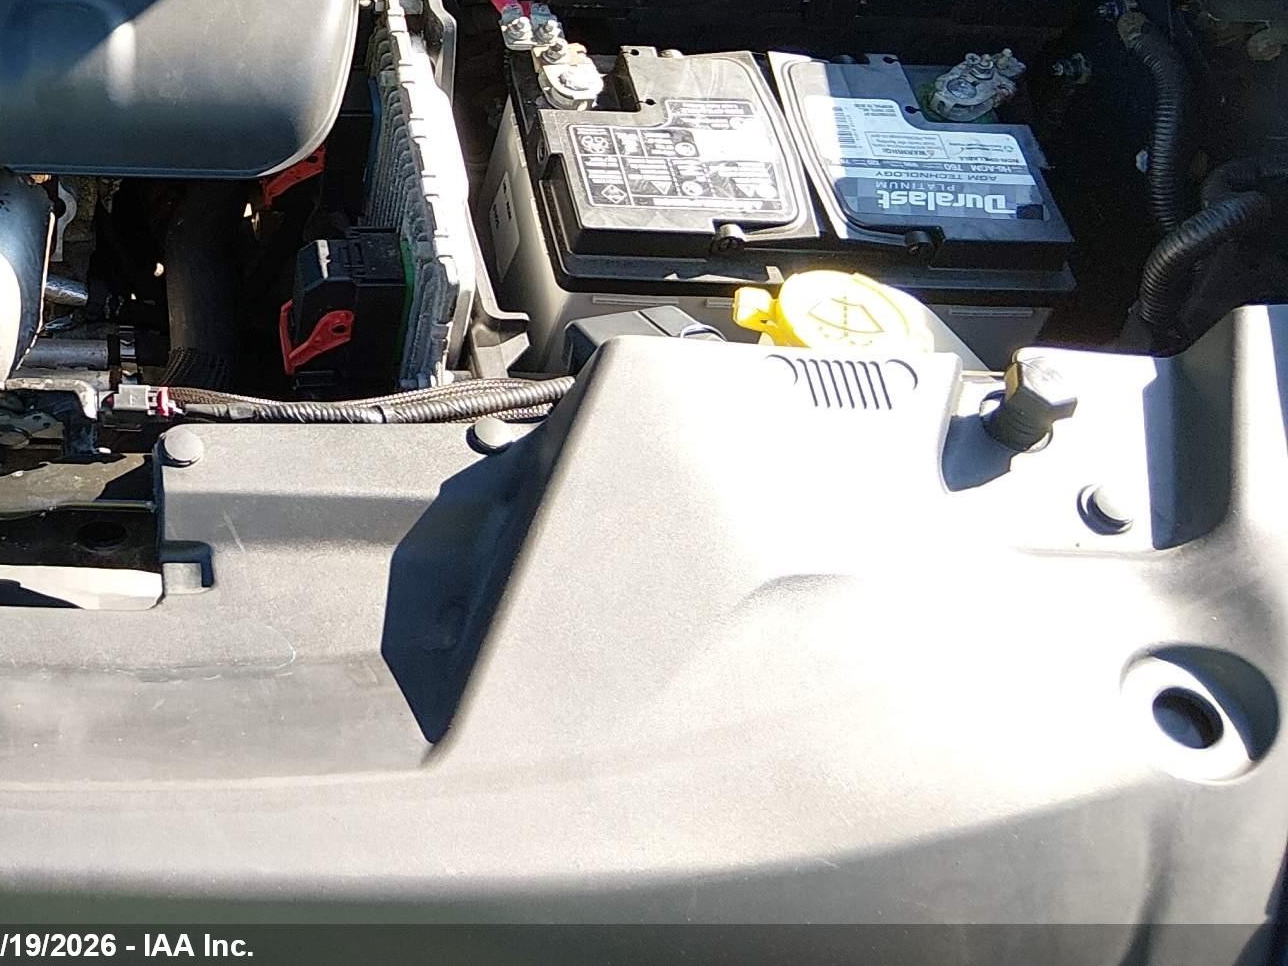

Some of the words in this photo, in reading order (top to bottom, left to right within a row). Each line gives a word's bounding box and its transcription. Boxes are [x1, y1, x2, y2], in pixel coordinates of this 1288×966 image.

[875, 170, 963, 181] TECHNOLOGY
[967, 173, 998, 182] AGM
[875, 180, 956, 192] PLATINUM
[875, 189, 1017, 214] Duralast
